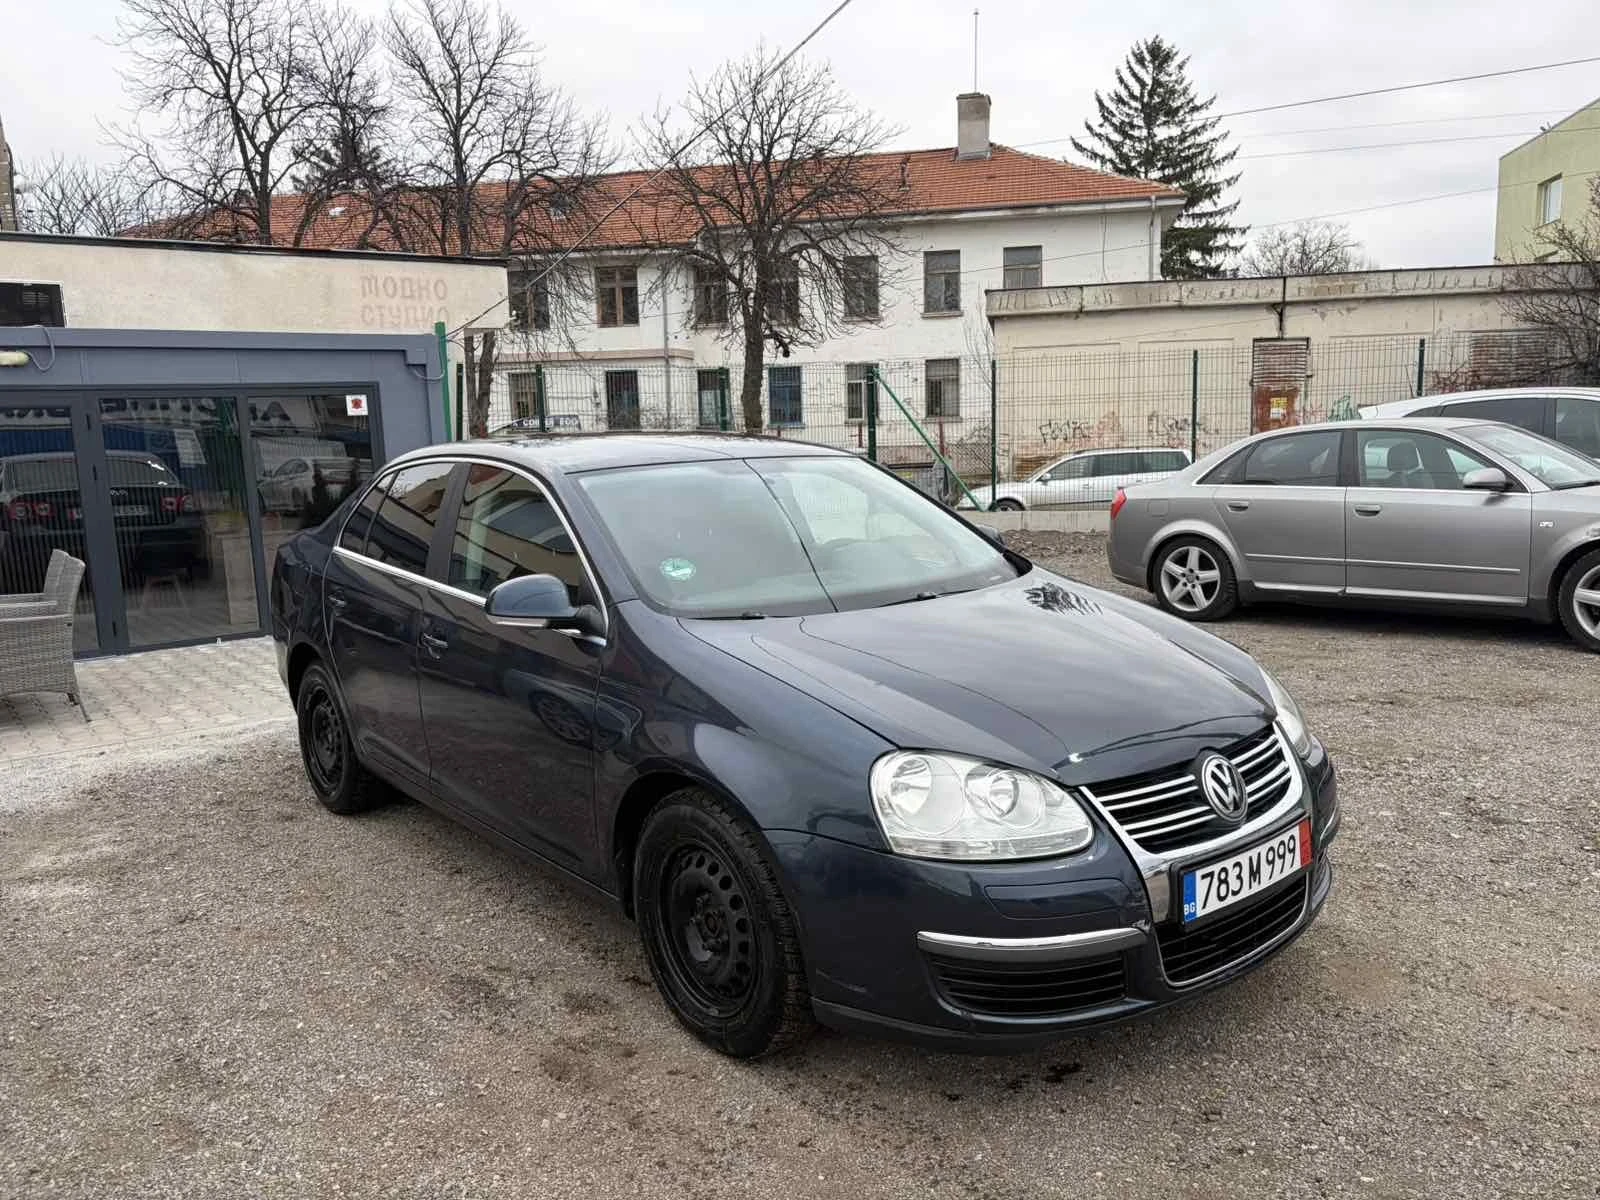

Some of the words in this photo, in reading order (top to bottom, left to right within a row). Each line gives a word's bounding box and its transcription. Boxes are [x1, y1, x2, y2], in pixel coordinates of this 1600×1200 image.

[1200, 861, 1244, 911] 783
[1265, 834, 1297, 881] 999
[1183, 902, 1196, 916] BG
